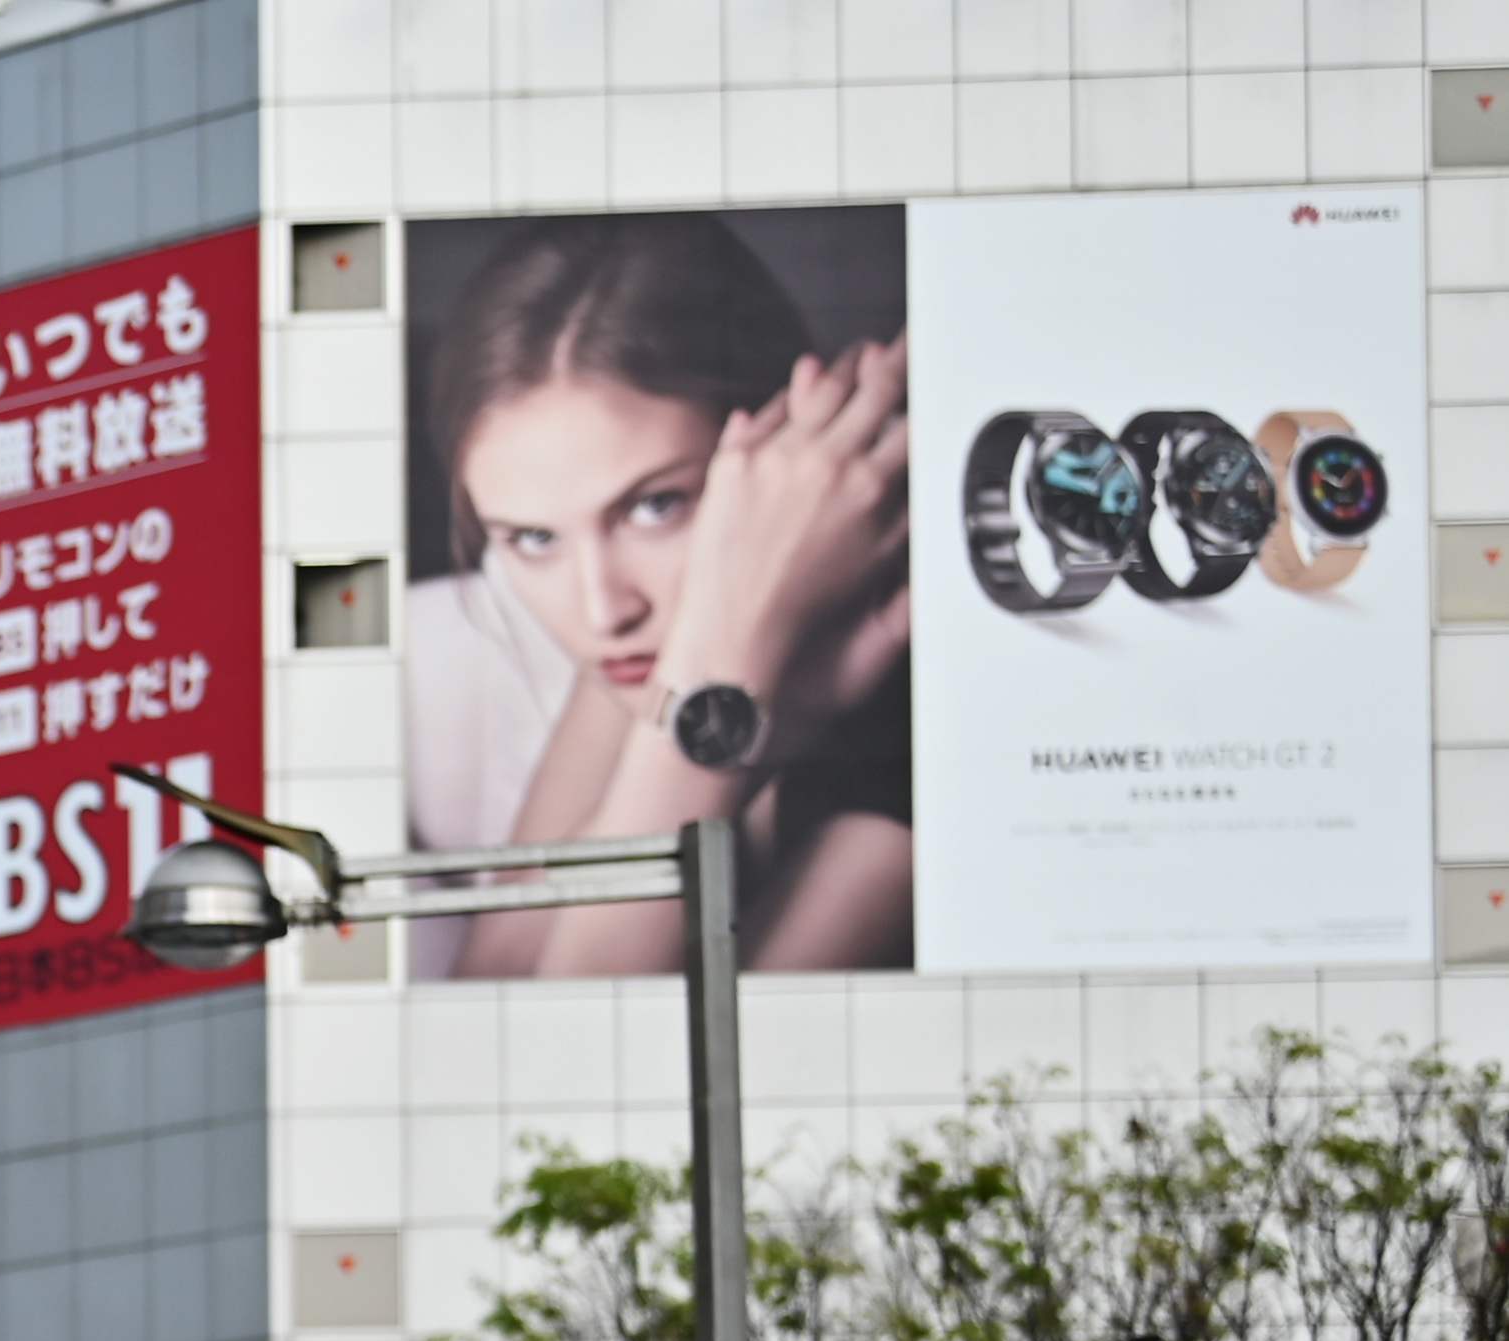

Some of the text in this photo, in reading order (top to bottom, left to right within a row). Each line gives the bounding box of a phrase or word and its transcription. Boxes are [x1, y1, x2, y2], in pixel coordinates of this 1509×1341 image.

[1324, 205, 1401, 223] HUAWEI
[44, 584, 159, 663] 押して
[43, 652, 210, 743] 押すだけ
[1031, 743, 1337, 776] HUAWEI WATCH GT 2
